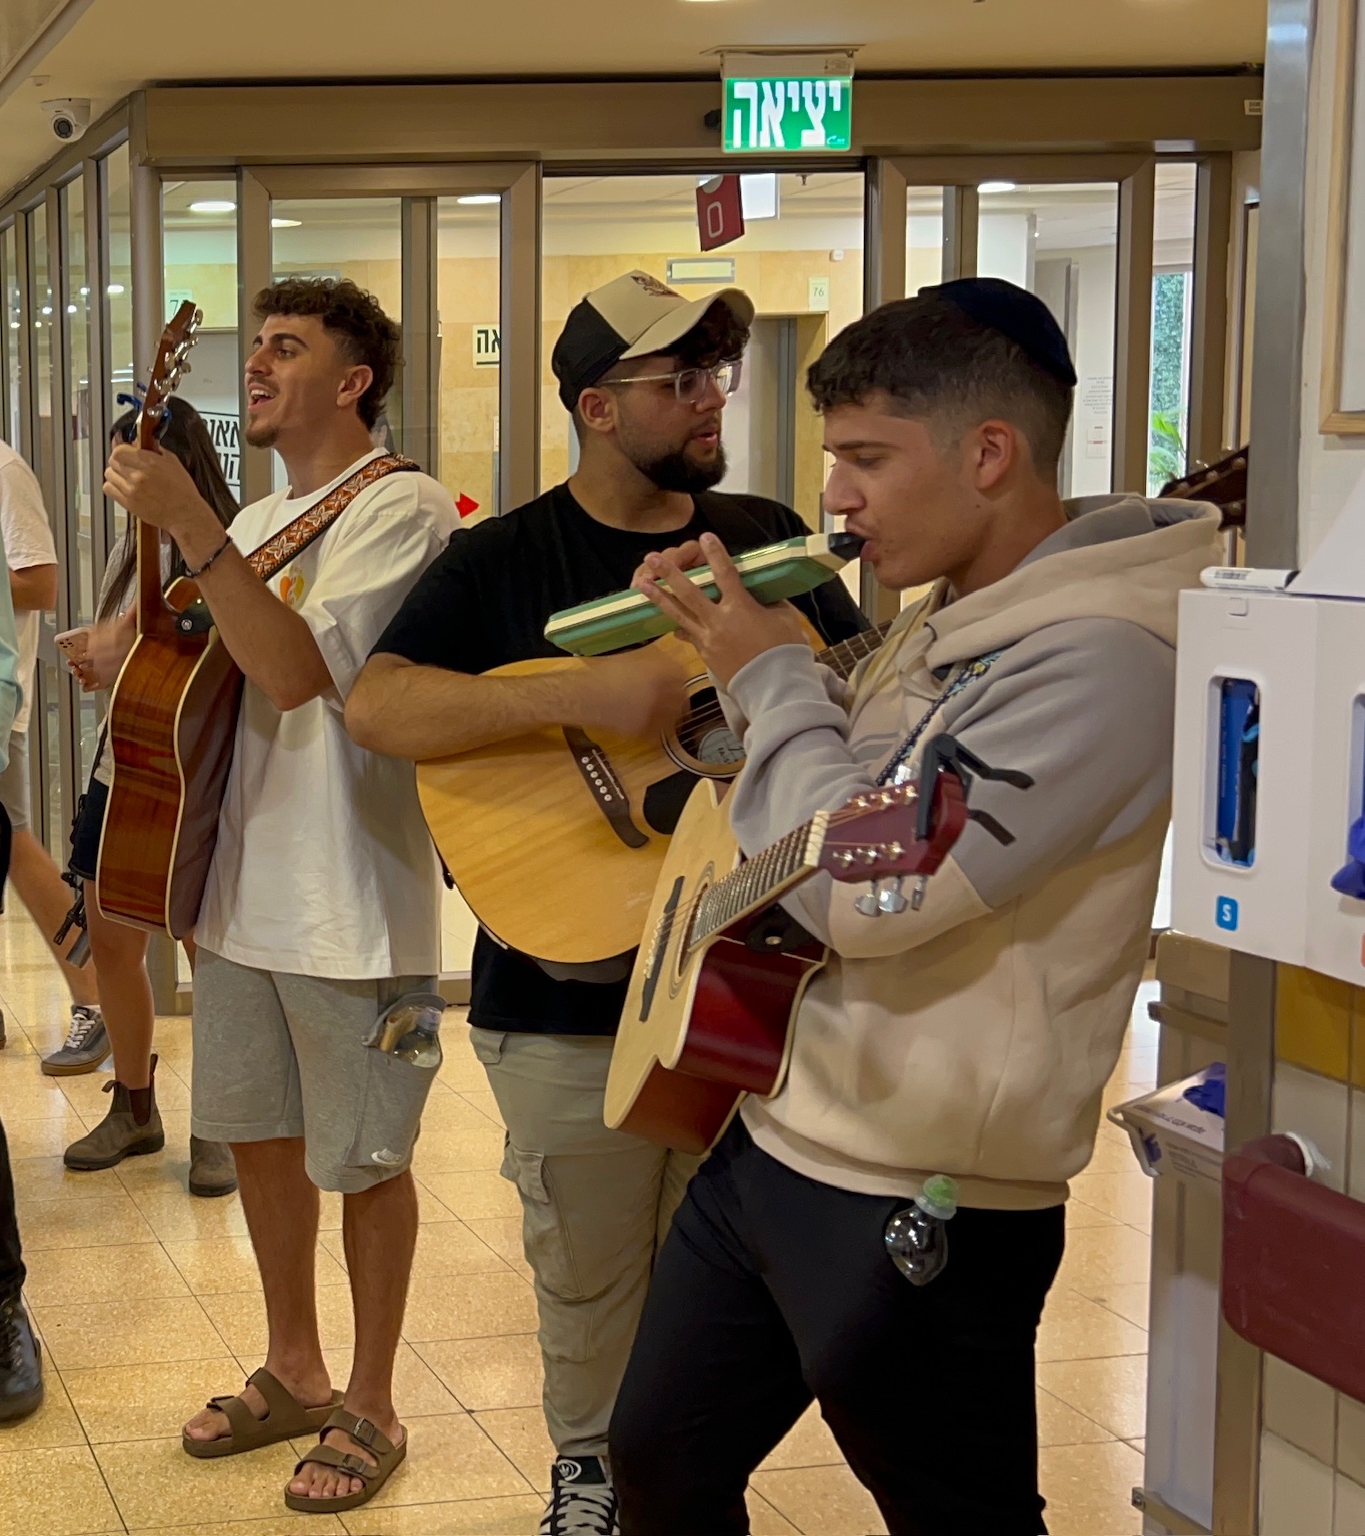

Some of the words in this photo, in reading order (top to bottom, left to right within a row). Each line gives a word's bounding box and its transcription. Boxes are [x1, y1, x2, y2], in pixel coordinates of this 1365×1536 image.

[733, 81, 841, 148] יציאה
[812, 286, 825, 297] 76
[1222, 904, 1232, 922] S
